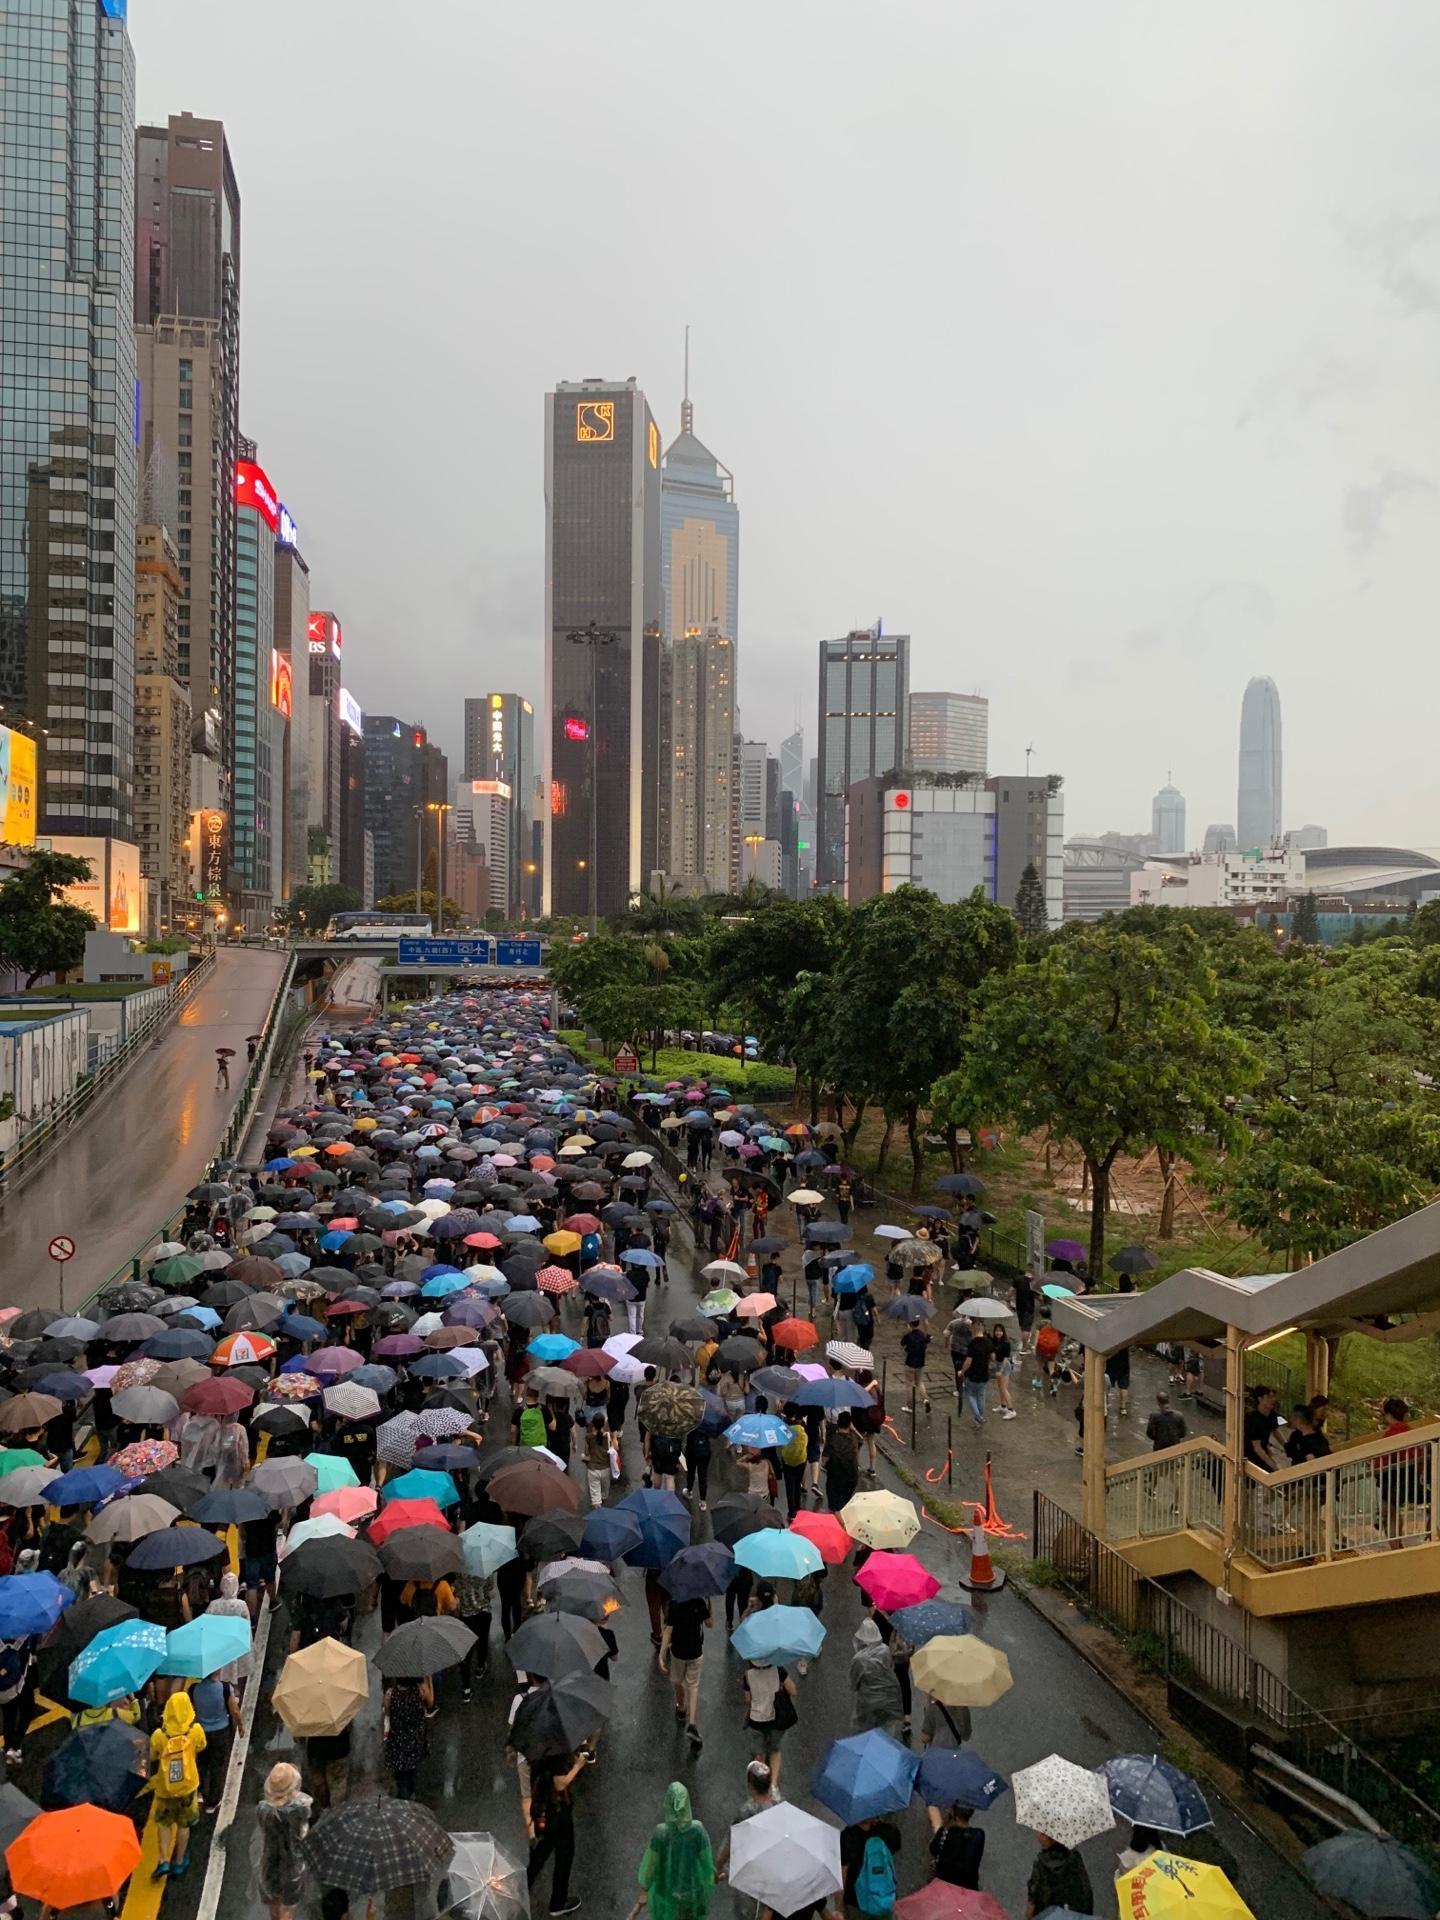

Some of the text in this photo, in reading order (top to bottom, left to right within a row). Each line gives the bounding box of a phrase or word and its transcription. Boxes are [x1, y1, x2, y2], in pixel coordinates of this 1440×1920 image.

[308, 641, 326, 653] BS
[207, 835, 222, 897] 東方棕泉
